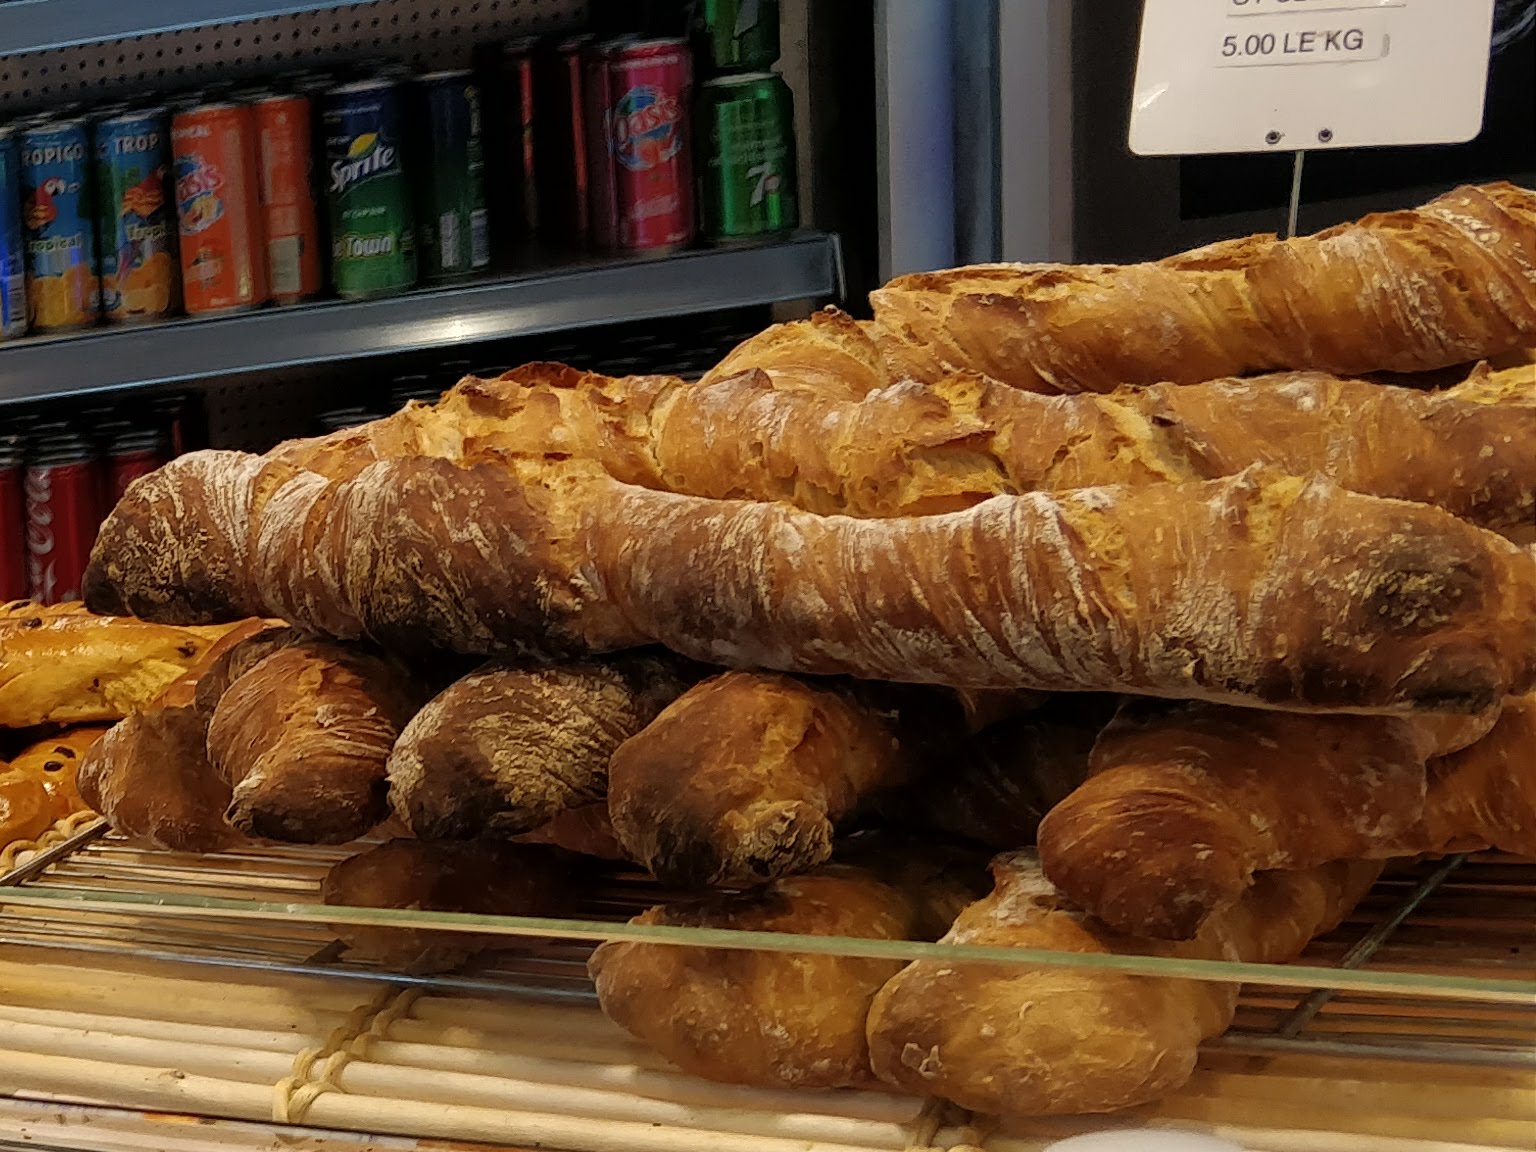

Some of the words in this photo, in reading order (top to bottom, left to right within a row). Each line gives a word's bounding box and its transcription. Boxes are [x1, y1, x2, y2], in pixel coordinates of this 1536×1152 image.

[1221, 33, 1276, 57] 5.00
[1283, 31, 1317, 54] LE
[1325, 28, 1363, 51] KG
[22, 143, 83, 166] ROPICO
[115, 133, 159, 156] TROP
[330, 144, 396, 194] Sprite
